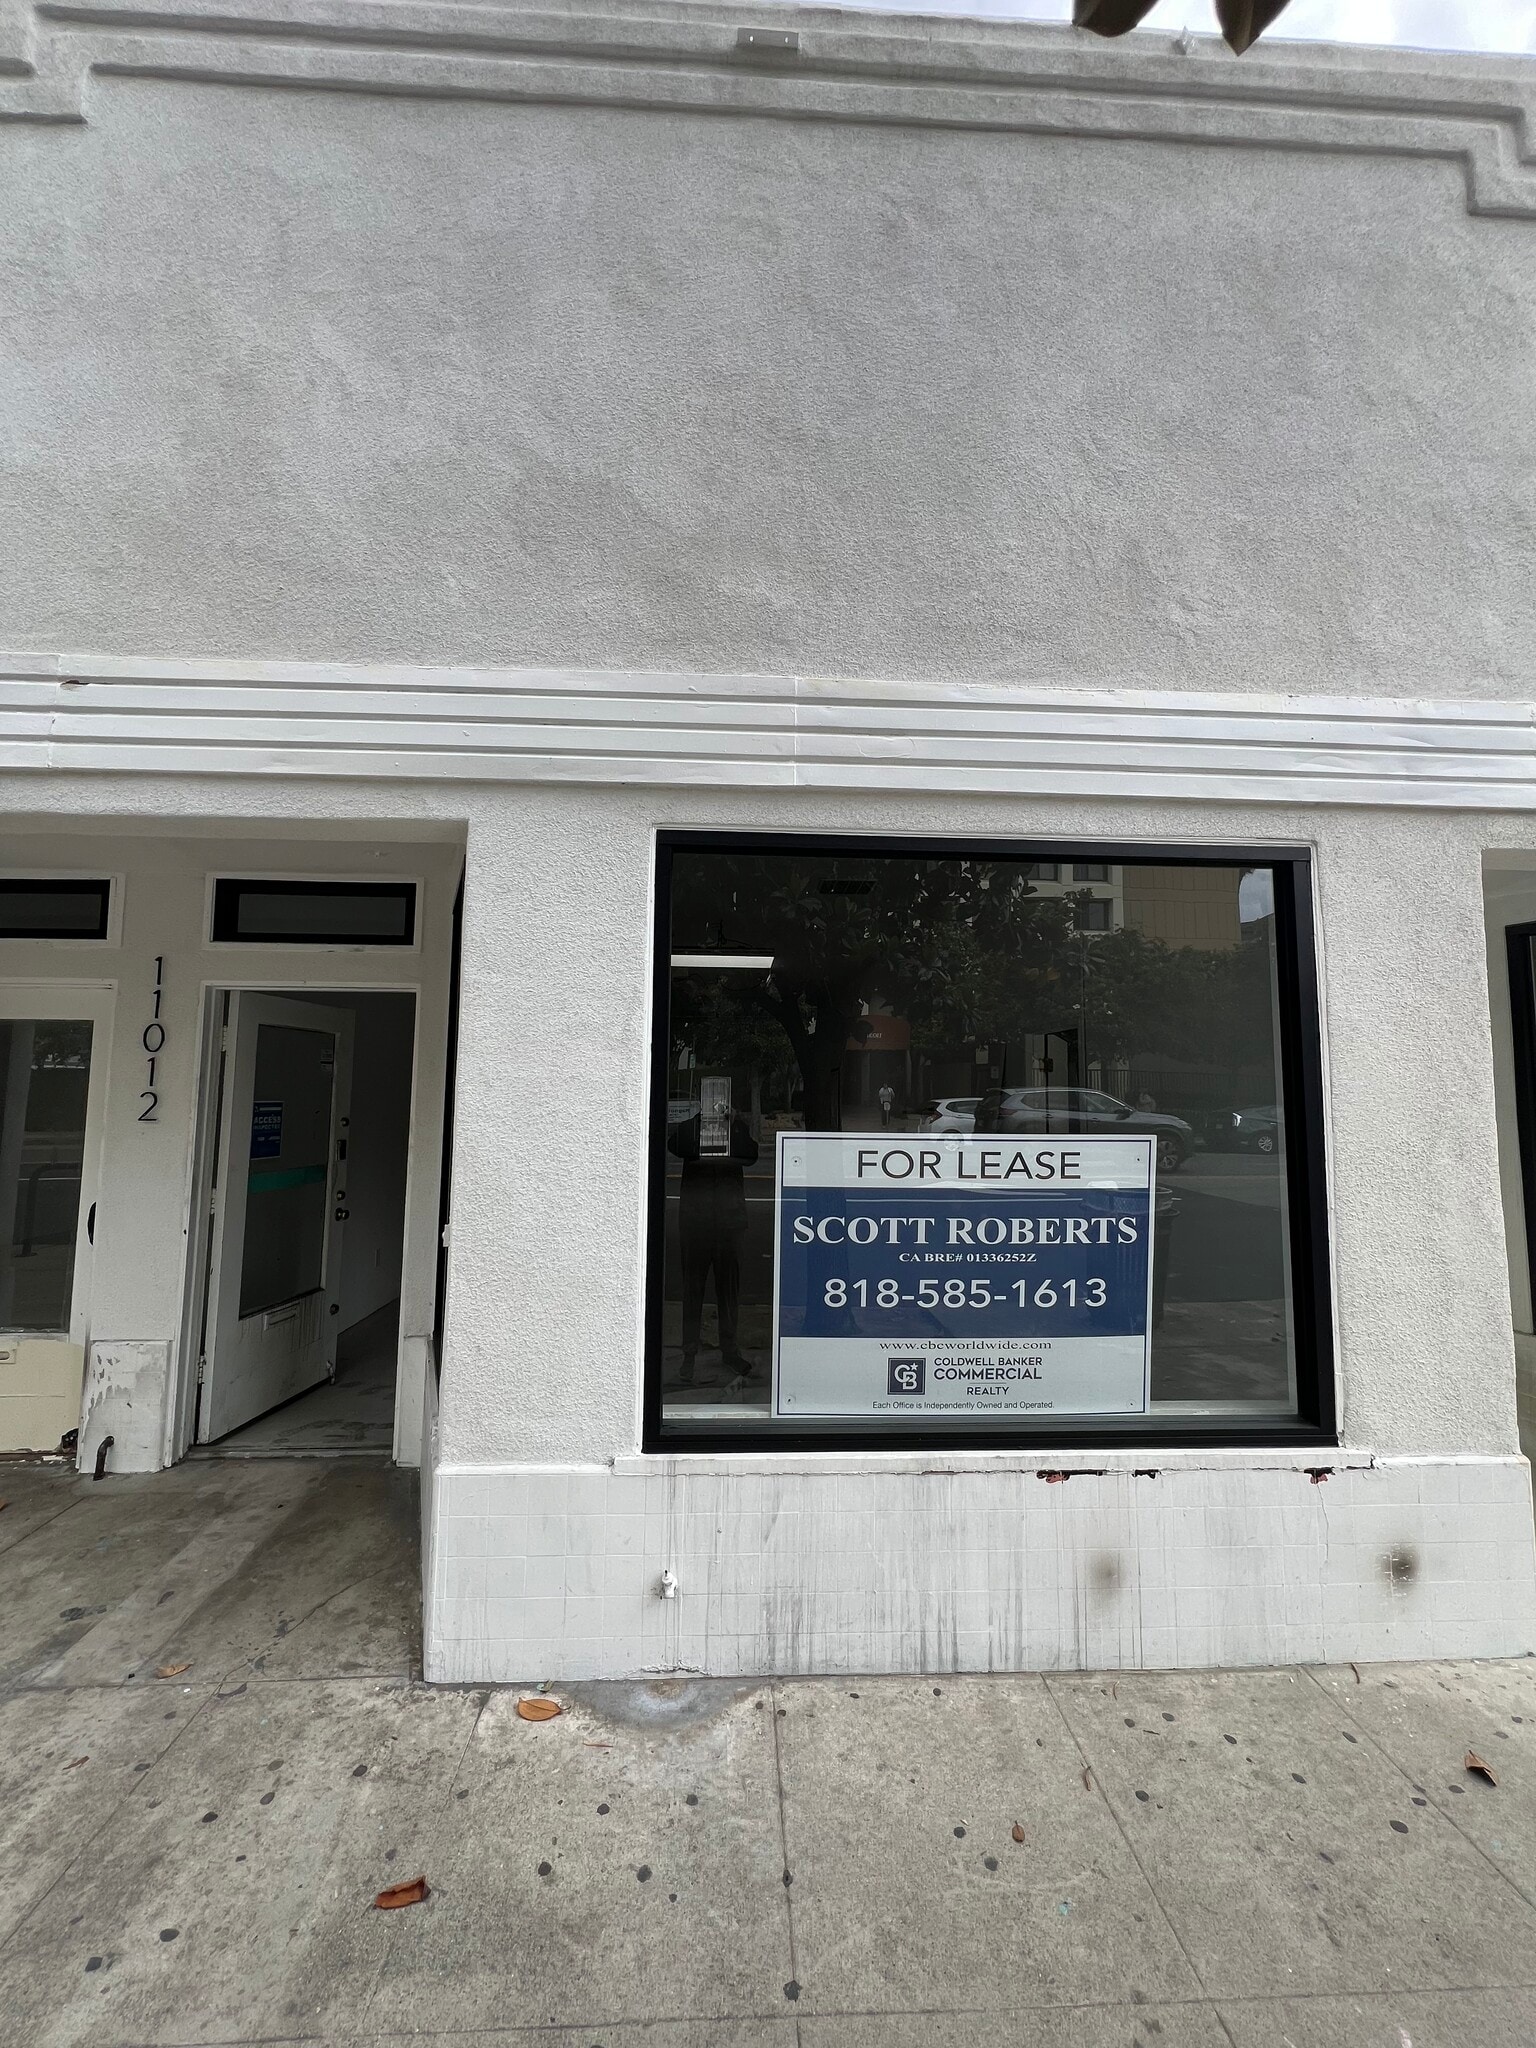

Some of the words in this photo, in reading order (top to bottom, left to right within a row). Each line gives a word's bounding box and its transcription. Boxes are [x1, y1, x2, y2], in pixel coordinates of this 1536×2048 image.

[138, 956, 166, 1122] 11012
[857, 1149, 942, 1179] FOR
[957, 1151, 1081, 1180] LEASE
[792, 1216, 935, 1245] SCOTT
[945, 1217, 1138, 1245] ROBERTS
[899, 1253, 921, 1262] CA
[924, 1253, 963, 1262] BRE#
[823, 1278, 1107, 1308] 818-585-1613
[879, 1340, 1052, 1350] www.cbcworldwide.com
[934, 1357, 995, 1366] COLDWELL
[998, 1357, 1043, 1366] BANKER
[933, 1368, 1042, 1380] COMMERCIAL
[966, 1386, 1010, 1395] REALTY
[872, 1401, 891, 1409] Each
[893, 1401, 914, 1409] Office
[916, 1401, 923, 1409] is
[924, 1401, 975, 1410] Independently
[976, 1401, 1002, 1409] Owned
